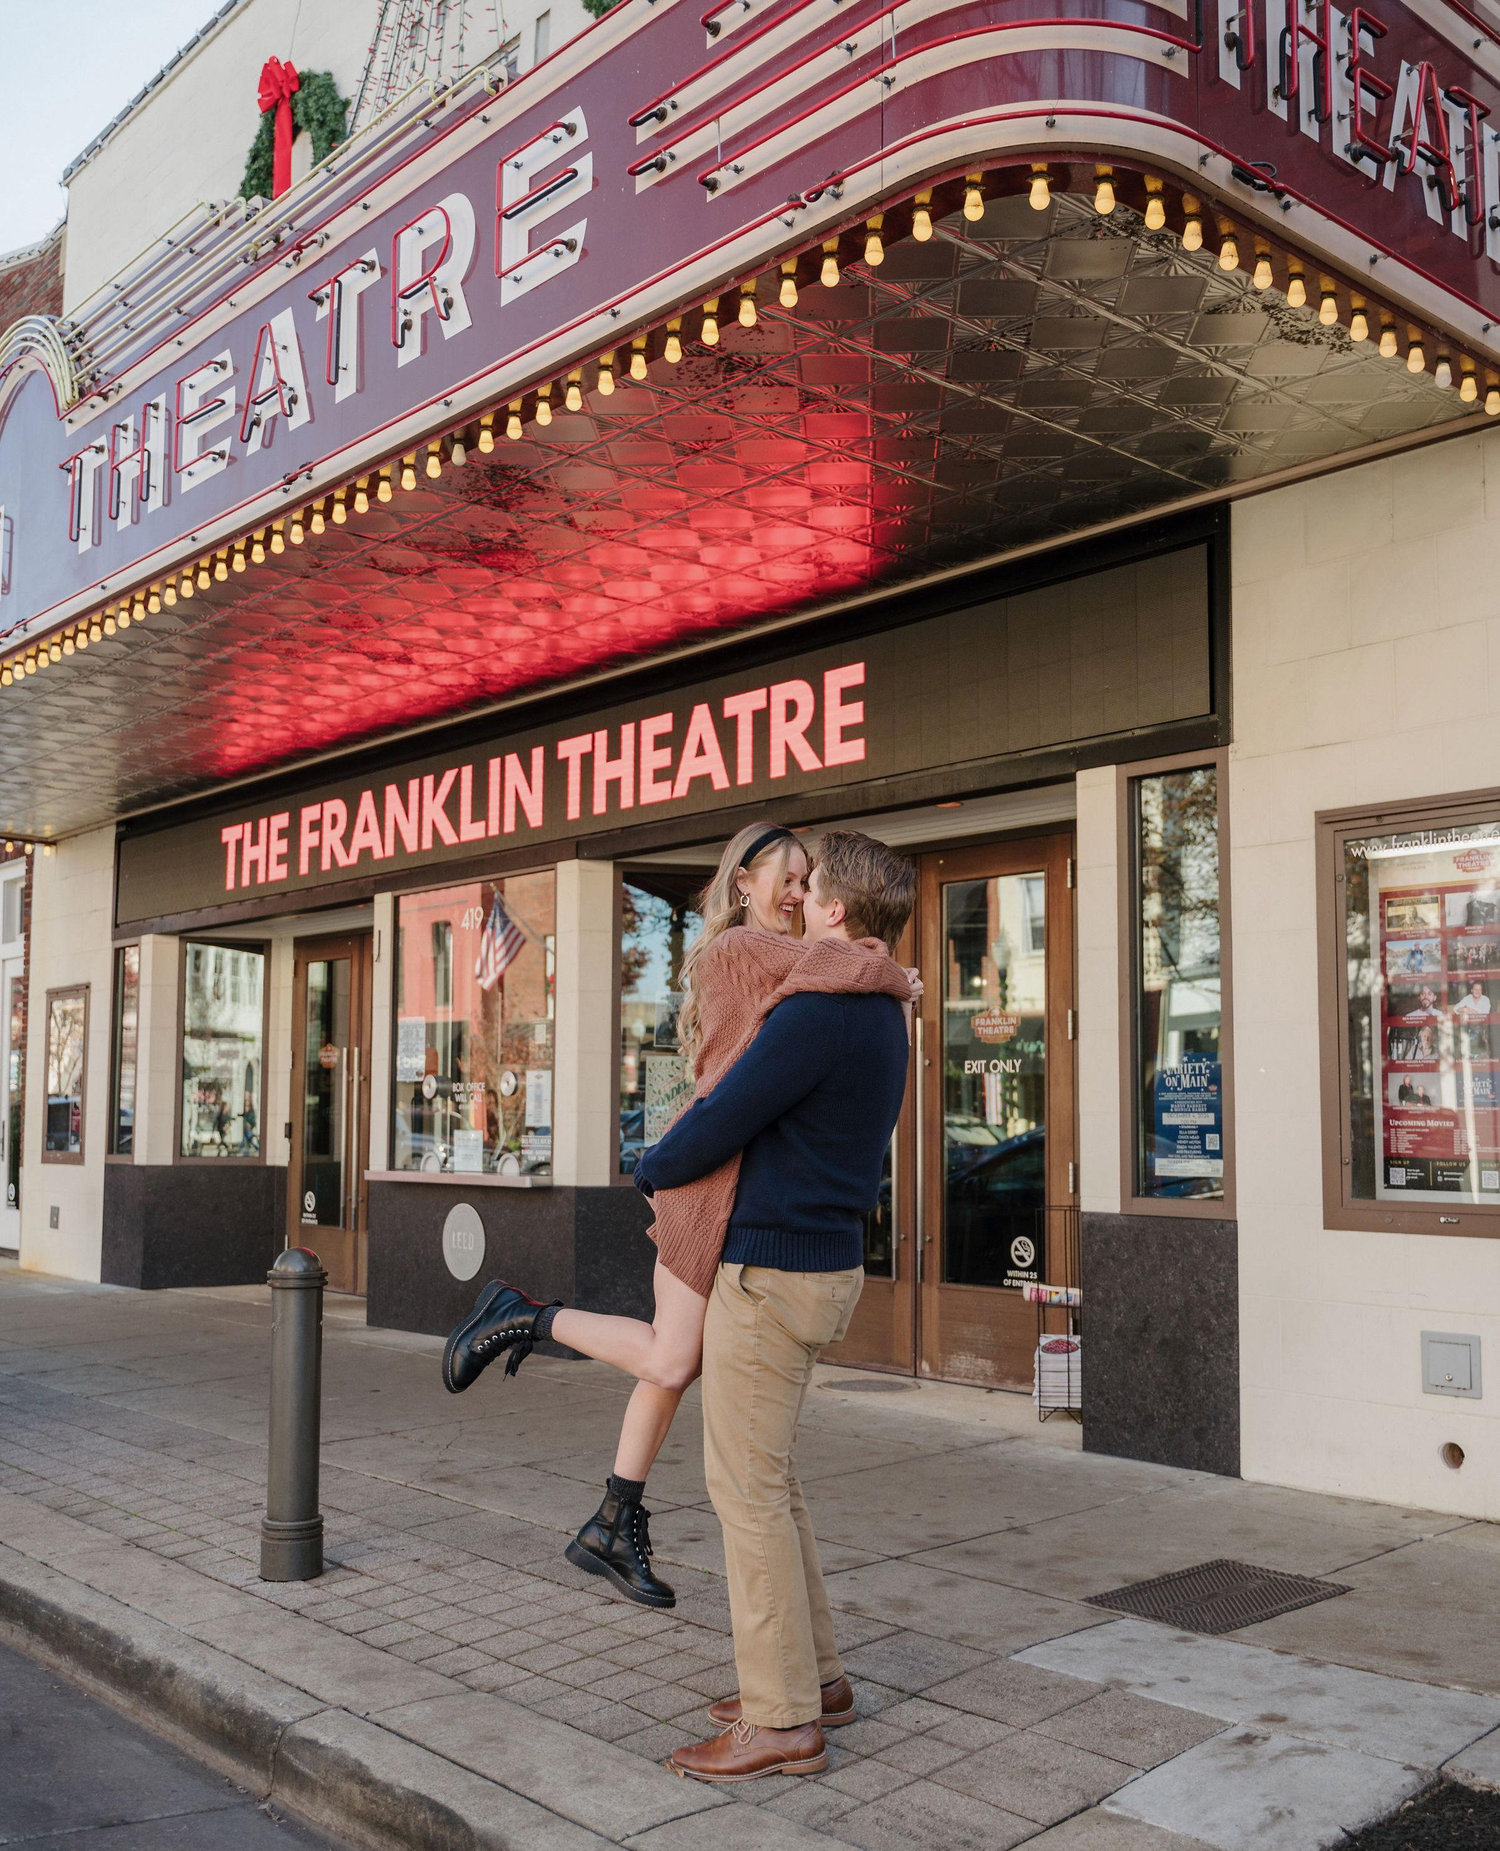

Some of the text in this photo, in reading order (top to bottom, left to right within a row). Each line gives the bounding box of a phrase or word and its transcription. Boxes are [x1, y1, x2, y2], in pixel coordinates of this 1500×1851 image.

[60, 106, 593, 554] THEATRE
[221, 661, 866, 891] THE FRANKLIN THEATRE
[460, 906, 484, 931] 419
[975, 1016, 1017, 1026] FRANKLIN
[978, 1025, 1015, 1035] THEATRE
[964, 1059, 1022, 1074] EXIT ONLY
[1164, 1062, 1210, 1075] VARIETY
[452, 1082, 486, 1092] BOX OFFICE
[1165, 1074, 1209, 1091] ON MAIN
[454, 1093, 467, 1102] WILL
[1389, 1119, 1426, 1127] UPCOMING
[452, 1231, 474, 1250] LEED
[1006, 1270, 1038, 1279] WITHIN 25
